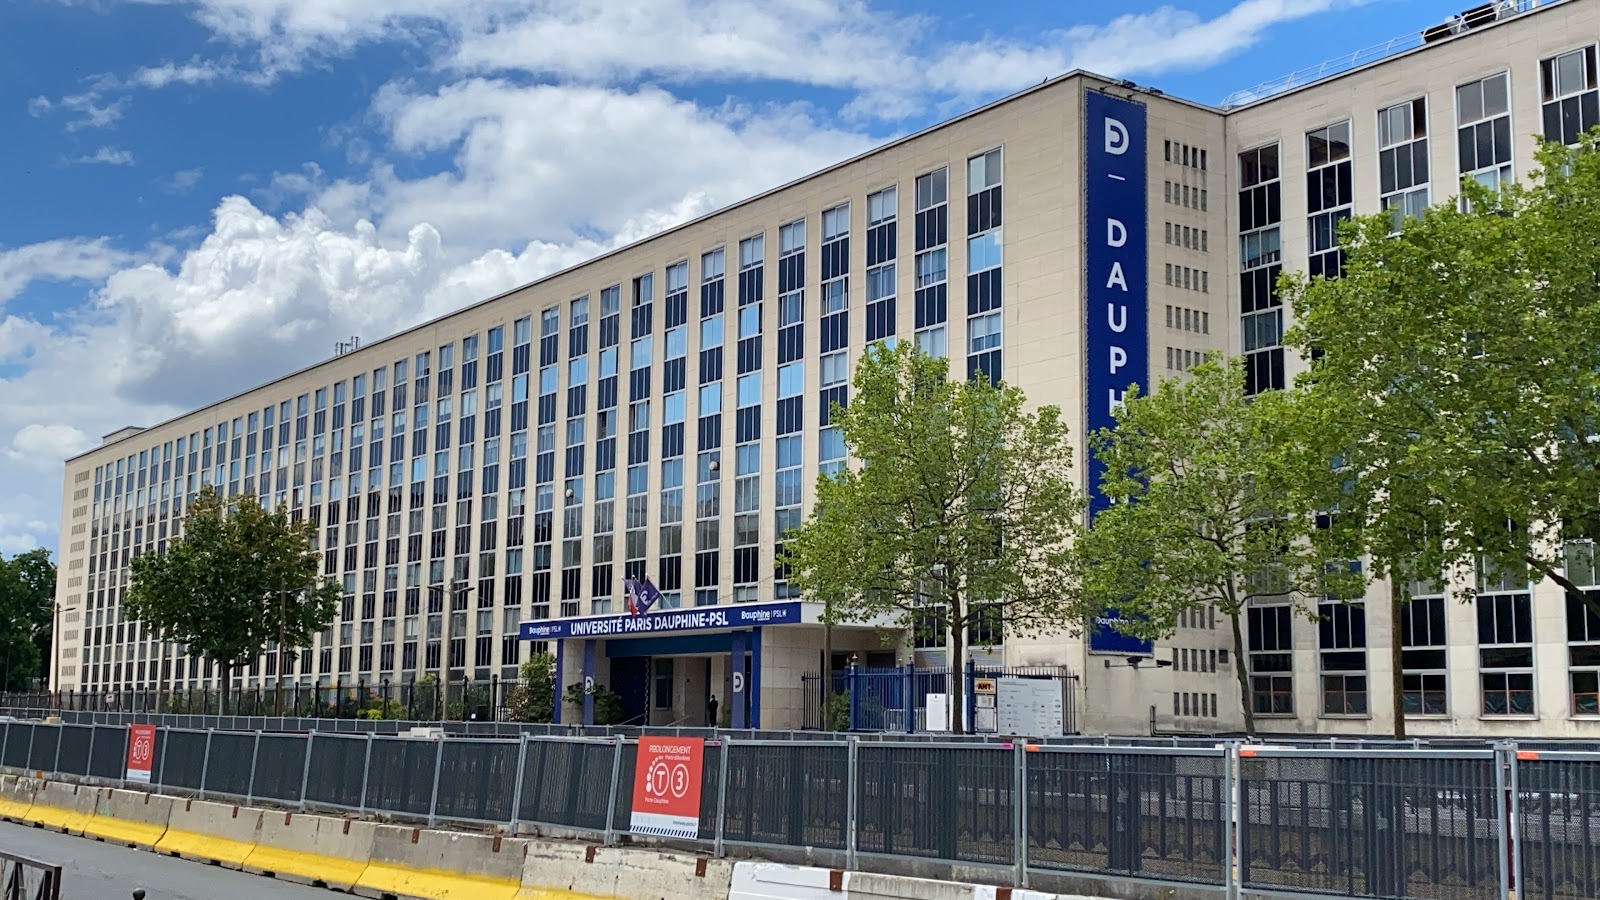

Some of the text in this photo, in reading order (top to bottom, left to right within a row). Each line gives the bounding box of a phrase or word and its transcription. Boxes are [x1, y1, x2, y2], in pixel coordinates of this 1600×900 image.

[1106, 217, 1129, 503] DAUPH
[570, 611, 729, 635] UNIVERSITÉ PARIS DAUPHINE-PSL
[741, 610, 770, 621] Dauphine
[529, 625, 550, 635] Dauphine
[649, 745, 691, 754] PROLONGEMENT
[657, 770, 684, 790] T 3
